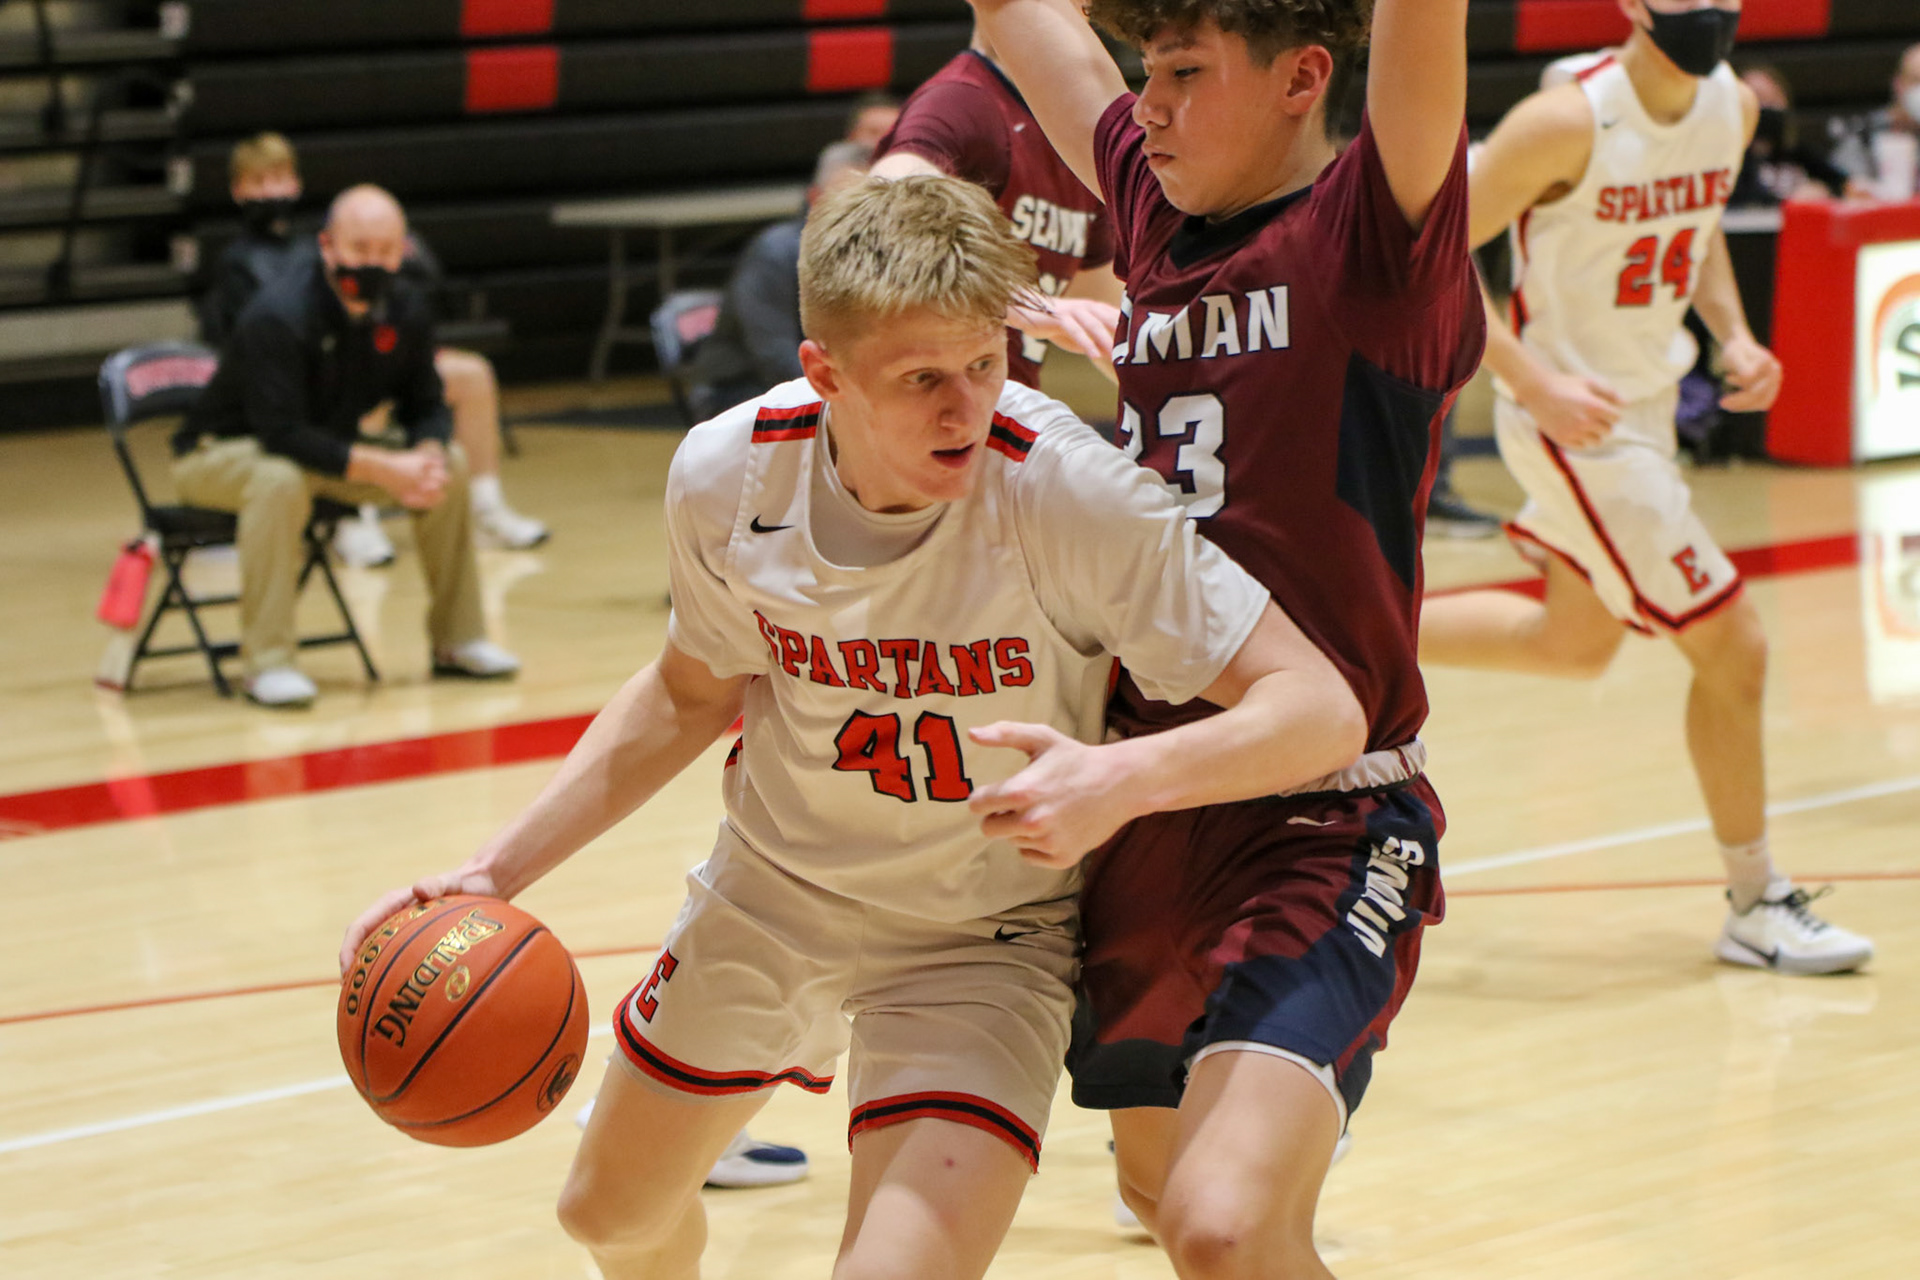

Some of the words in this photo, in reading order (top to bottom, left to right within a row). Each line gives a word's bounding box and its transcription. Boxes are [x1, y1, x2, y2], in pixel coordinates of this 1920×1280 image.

[1010, 194, 1096, 258] SEAM
[1595, 168, 1731, 223] SPARTANS
[1614, 227, 1698, 307] 24
[1671, 545, 1711, 596] E
[753, 609, 1034, 699] SPARTANS
[831, 708, 974, 803] 41
[374, 907, 505, 1048] SPALDING
[636, 947, 679, 1024] E
